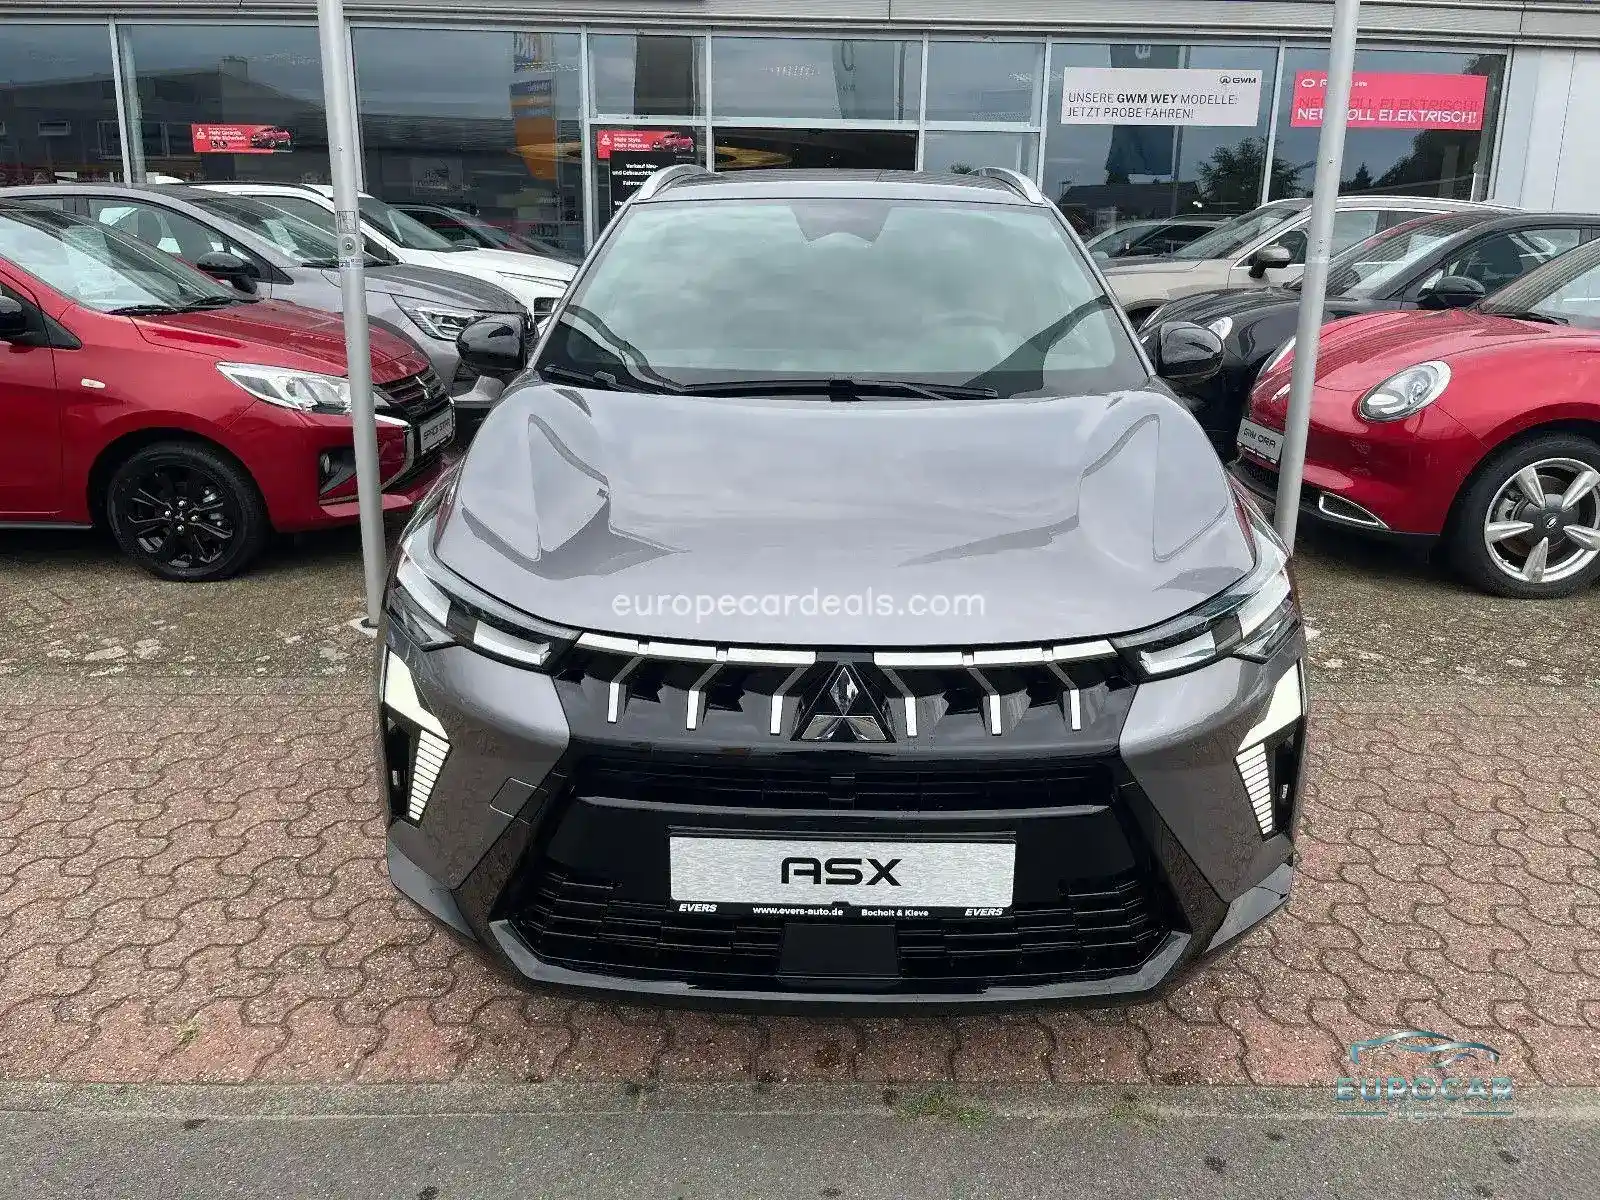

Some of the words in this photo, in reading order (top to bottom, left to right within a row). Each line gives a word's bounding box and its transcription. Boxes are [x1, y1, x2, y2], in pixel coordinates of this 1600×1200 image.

[1068, 92, 1114, 103] UNSERE
[1116, 93, 1148, 104] GWM
[1150, 94, 1179, 104] WEY
[1180, 94, 1239, 105] MODELLE:
[1067, 107, 1101, 117] JETZT
[1103, 107, 1142, 118] PROBE
[1145, 108, 1194, 119] FAHREN!
[1346, 108, 1376, 121] OLL
[1378, 109, 1477, 123] ELEKTRISCH!
[781, 857, 903, 887] ASX
[679, 903, 718, 913] EVERS
[752, 906, 844, 916] www.evers-auto.de
[861, 908, 895, 917] Bocholt
[896, 908, 903, 917] &
[904, 908, 929, 917] Kleve
[964, 908, 1004, 916] EVERS
